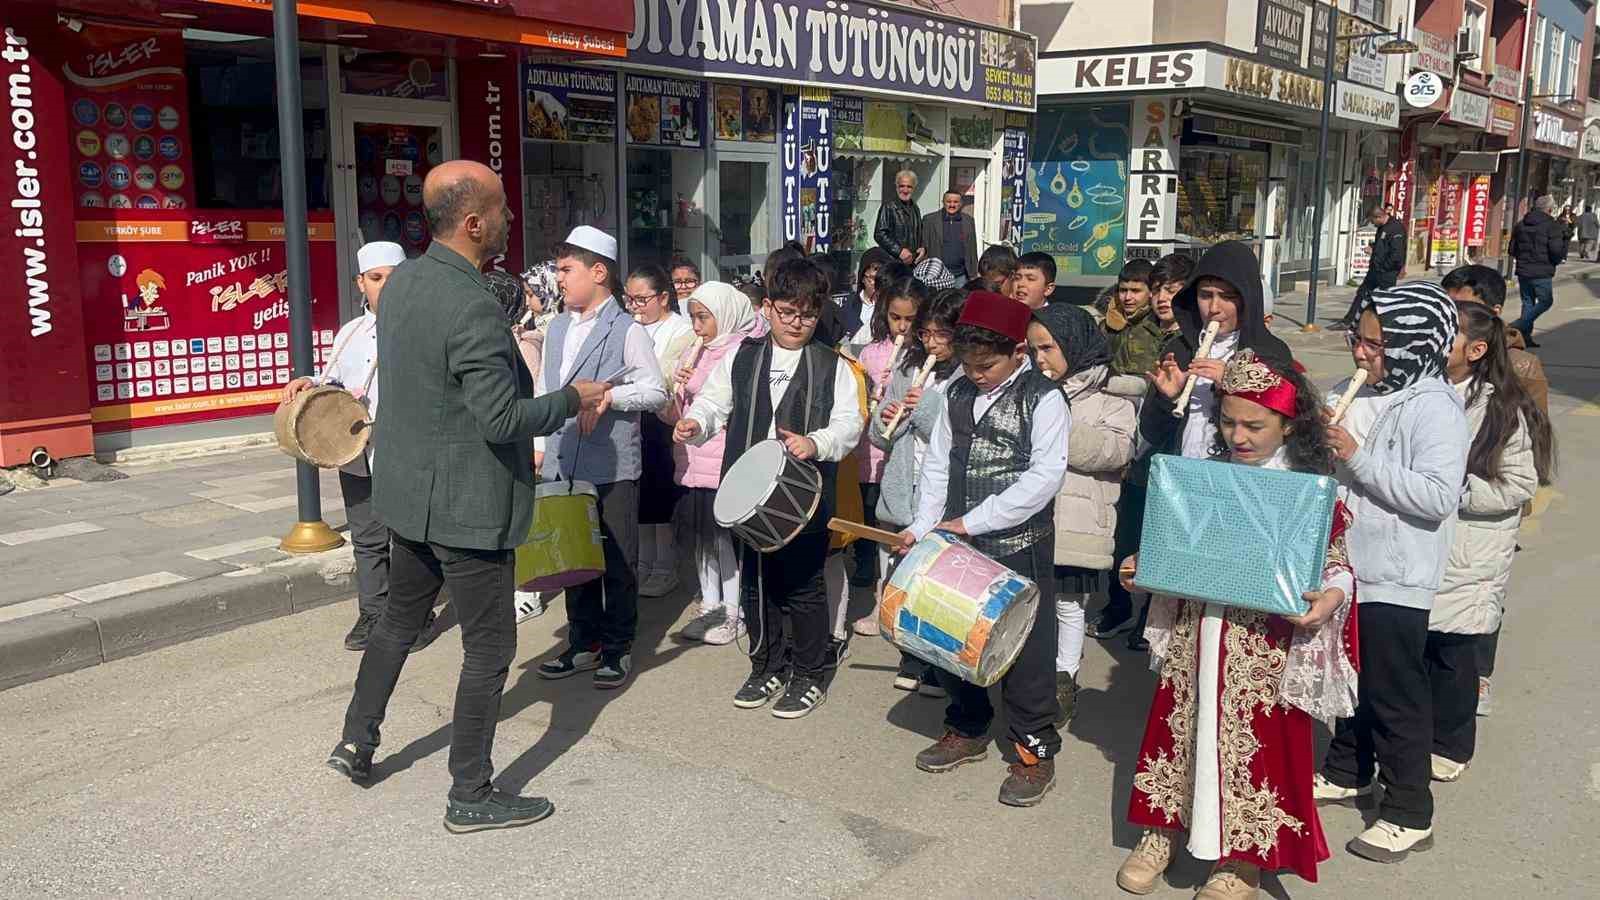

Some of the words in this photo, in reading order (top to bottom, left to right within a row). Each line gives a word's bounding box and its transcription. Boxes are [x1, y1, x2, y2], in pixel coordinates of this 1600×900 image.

[546, 30, 580, 48] Yerköy
[1264, 5, 1302, 41] AVUKAT
[806, 1, 975, 92] TÜTÜNCÜSÜ
[527, 69, 569, 88] ADIYAMAN
[570, 71, 614, 92] TÜTÜNCÜSÜ
[626, 77, 661, 94] ADIYAMAN
[1011, 72, 1032, 89] SALAN
[1074, 53, 1194, 88] KELEŞ
[2, 26, 52, 337] www.isler.com.tr
[1139, 102, 1165, 241] SARRAF
[1472, 184, 1488, 239] MATBAASI
[186, 262, 225, 287] Panik
[228, 251, 257, 272] YOK
